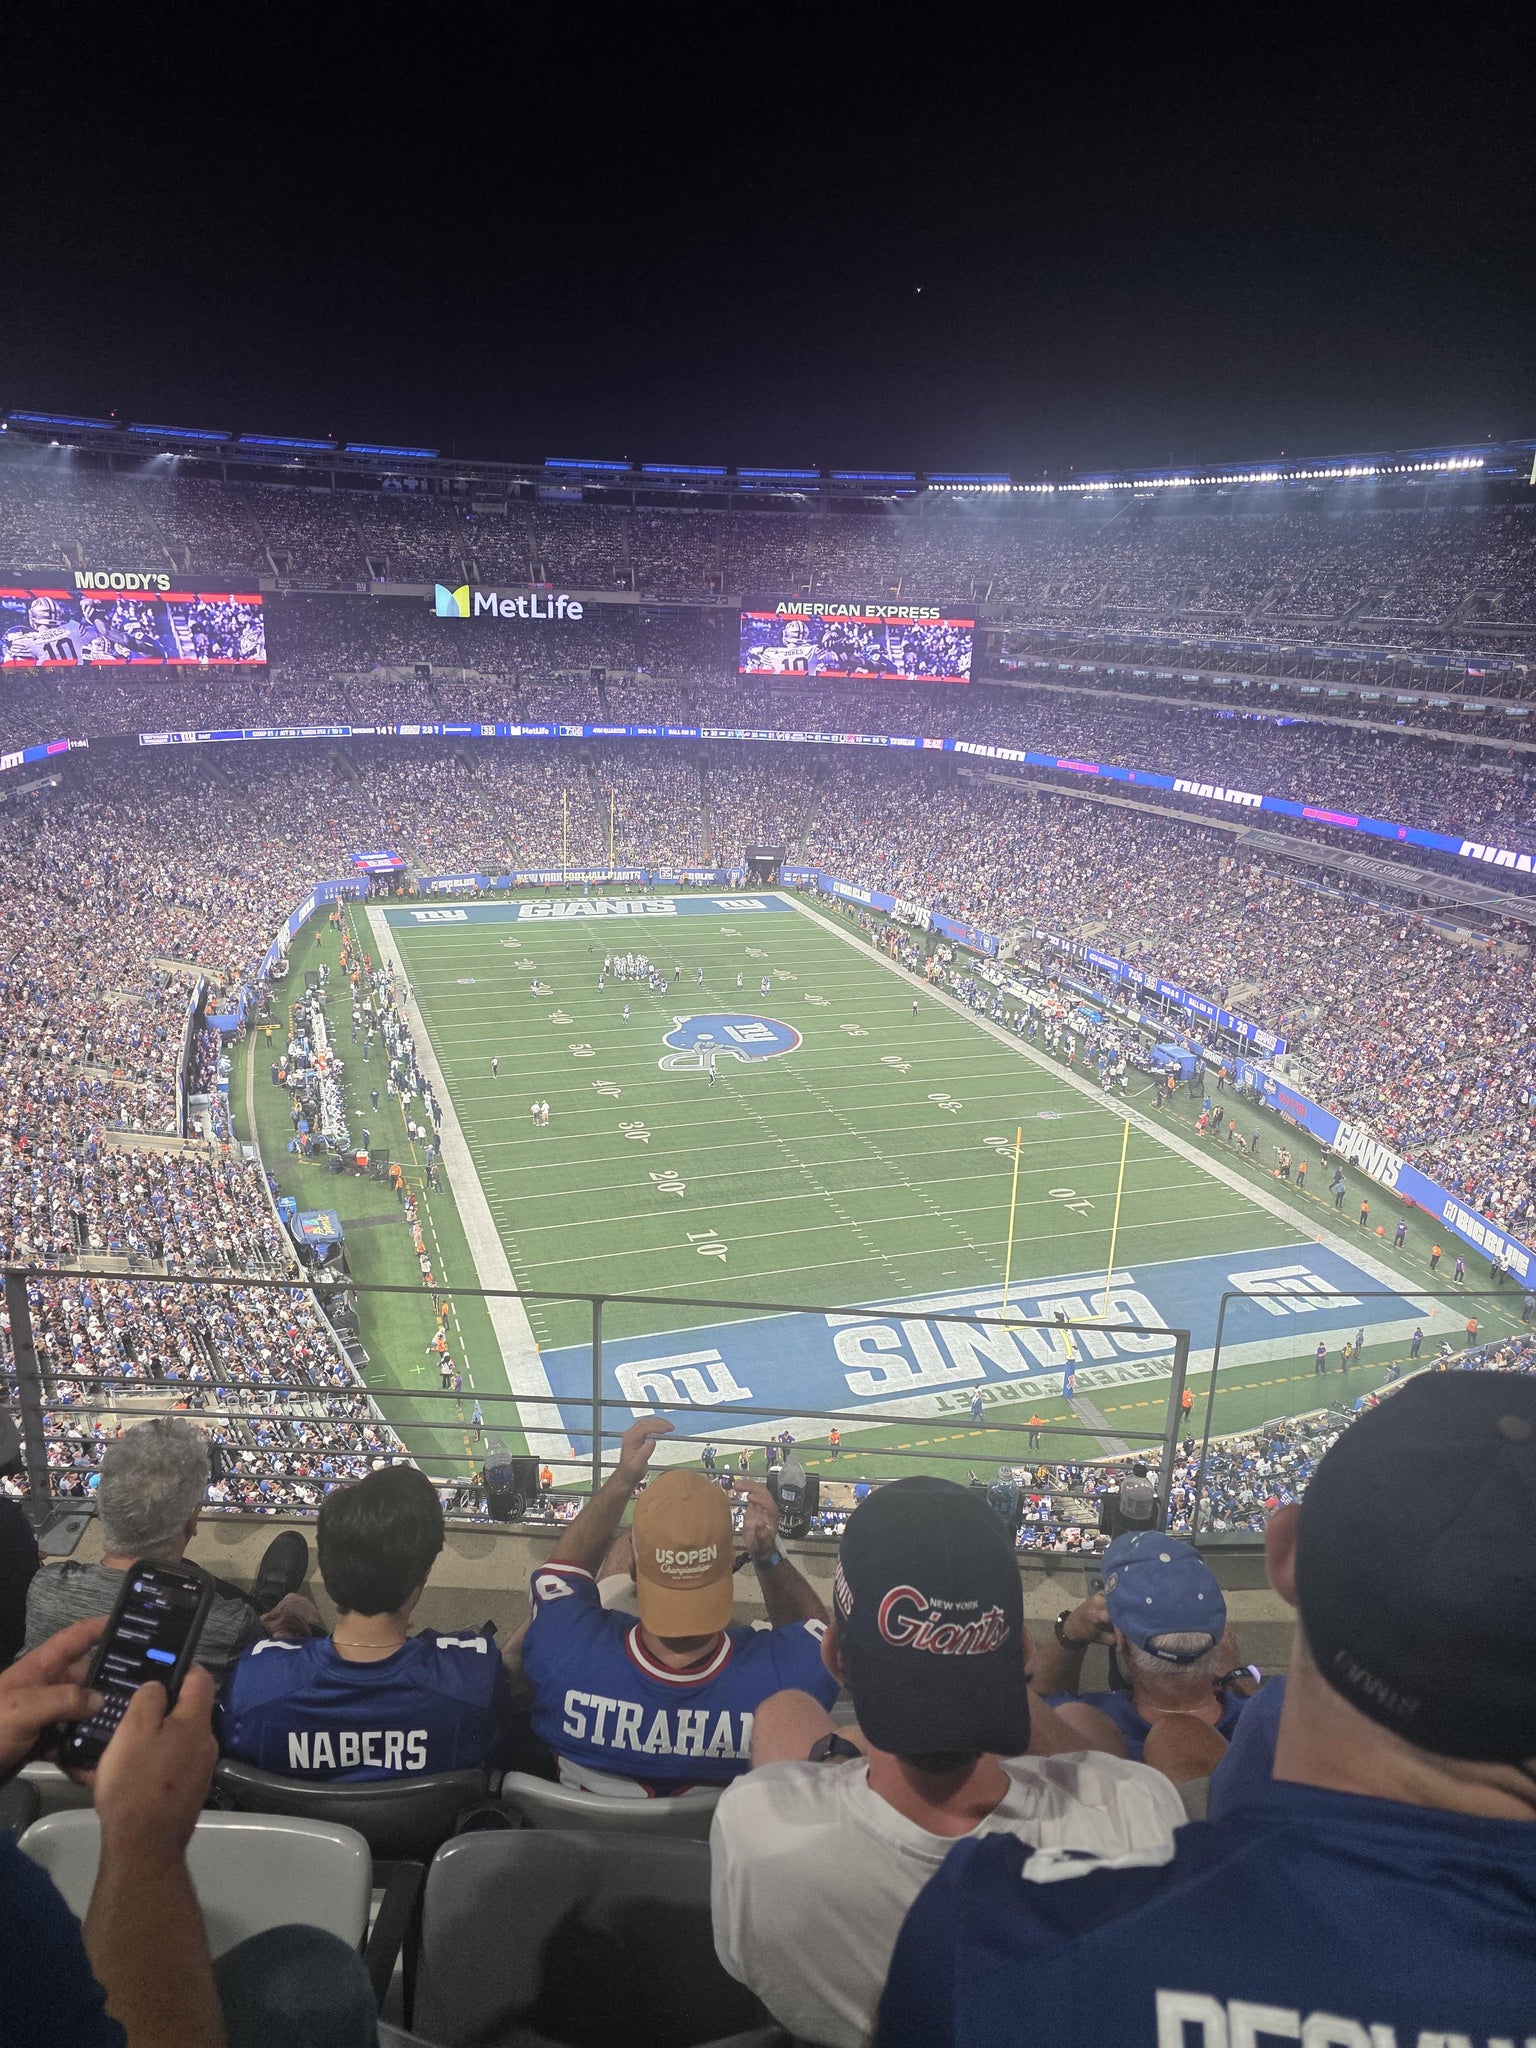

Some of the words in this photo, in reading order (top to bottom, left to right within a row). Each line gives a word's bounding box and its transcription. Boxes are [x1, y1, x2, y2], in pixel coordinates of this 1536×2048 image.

[75, 571, 171, 591] MOODY'S
[474, 591, 584, 620] MetLife
[775, 601, 861, 618] AMERICAN
[865, 605, 941, 619] EXPRESS
[42, 637, 79, 661] 10
[780, 656, 809, 672] 10
[522, 726, 550, 736] MetLife
[517, 873, 538, 884] NEW
[539, 872, 564, 883] YORK
[1342, 856, 1386, 875] METLIFE
[1378, 865, 1425, 882] STADIUM
[518, 899, 677, 918] GIANTS
[711, 899, 768, 910] ny
[410, 909, 469, 922] ny
[1128, 967, 1143, 983] 7:06
[840, 1023, 869, 1036] 50
[1236, 1020, 1249, 1036] 28
[1254, 1029, 1278, 1051] GIANTS
[568, 1043, 596, 1057] 50
[1202, 1049, 1223, 1066] GIANTS
[880, 1055, 912, 1071] 40
[592, 1080, 622, 1095] 40
[927, 1093, 963, 1110] 30
[618, 1121, 651, 1140] 30
[983, 1136, 1025, 1156] 20
[1333, 1120, 1405, 1188] GIANTS
[648, 1170, 686, 1192] 20
[1048, 1188, 1096, 1212] 10
[686, 1228, 728, 1256] 10
[1442, 1200, 1459, 1223] GO
[1455, 1208, 1486, 1246] BIG
[1483, 1228, 1530, 1279] BLUE
[833, 1289, 1178, 1398] GIANTS
[1078, 1358, 1176, 1386] NEVER
[936, 1380, 1063, 1413] FORGET
[655, 1548, 675, 1565] US
[675, 1544, 718, 1566] OPEN
[929, 1597, 954, 1611] NEW
[954, 1600, 979, 1612] YORK
[878, 1584, 1010, 1656] Giants
[287, 1729, 428, 1771] NABERS
